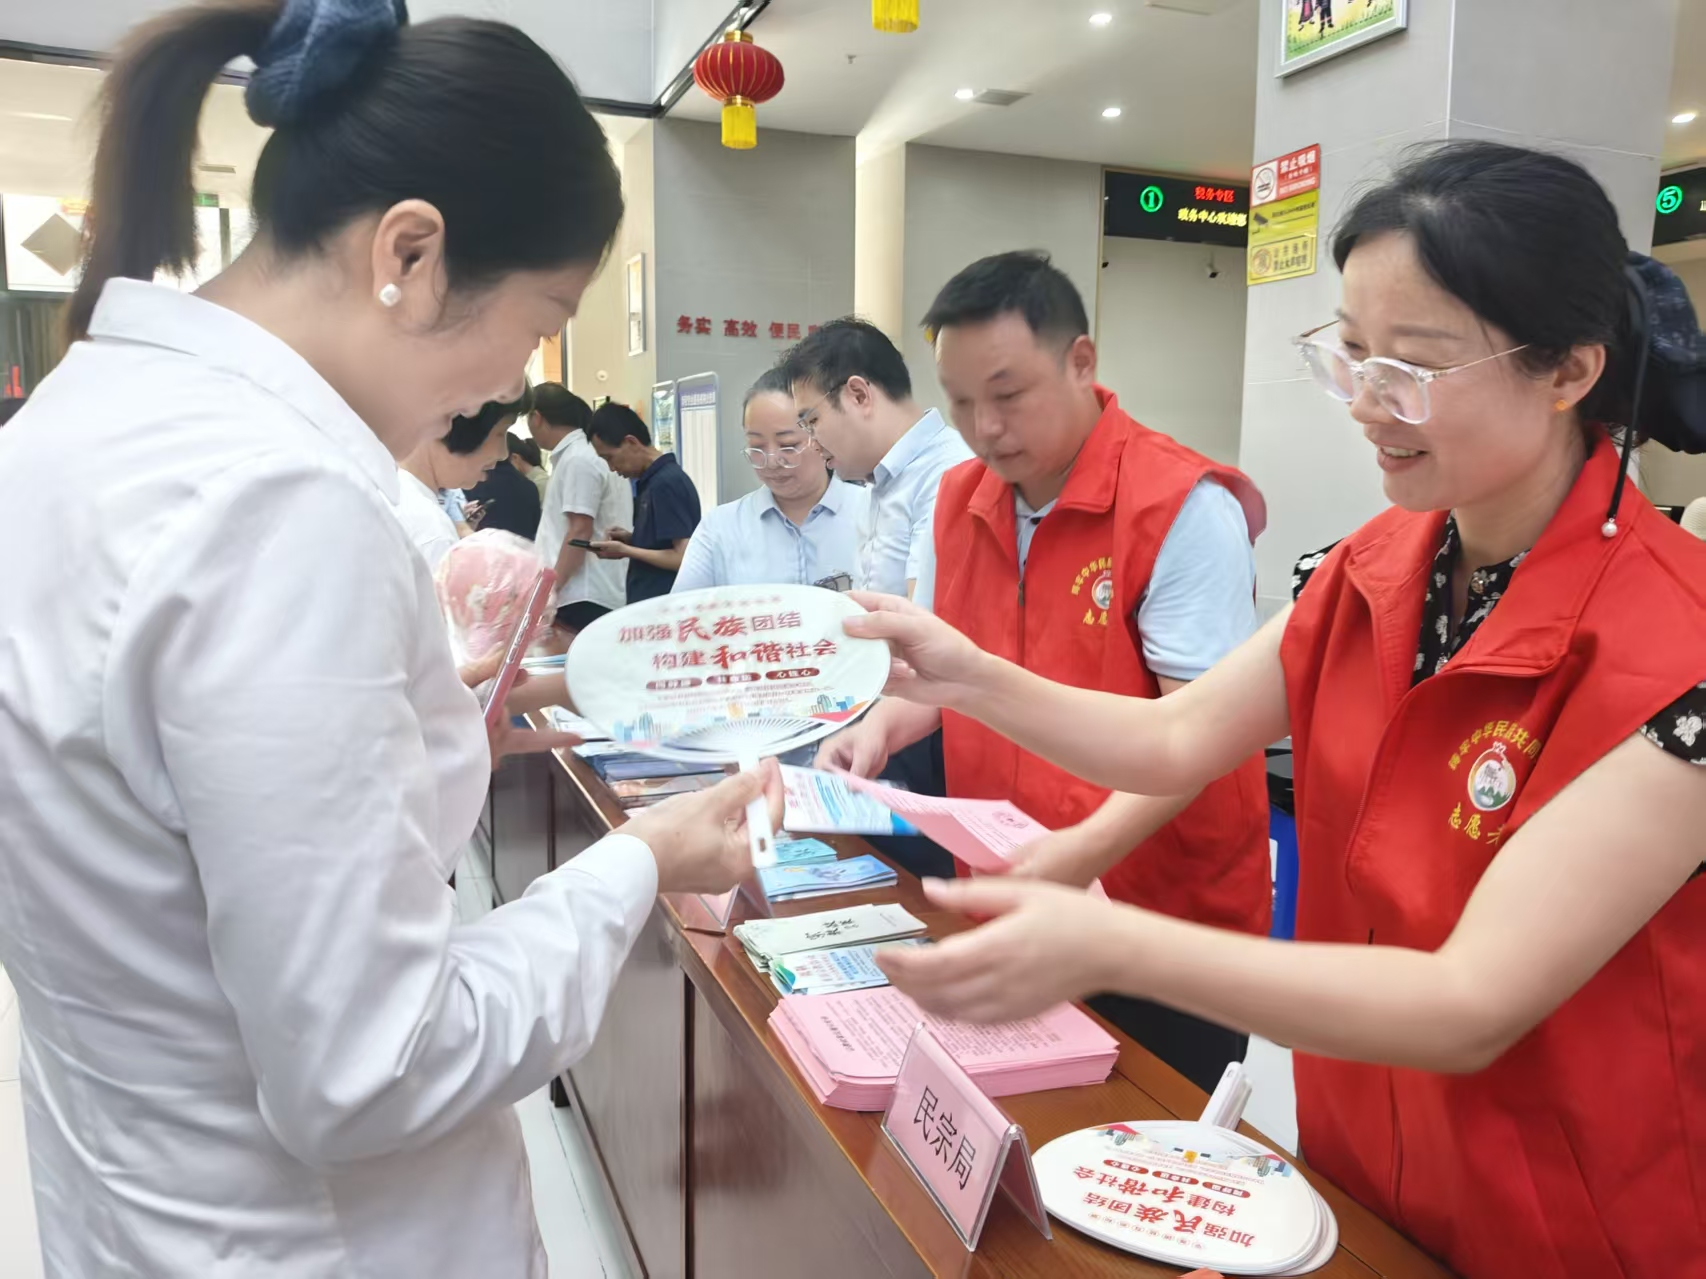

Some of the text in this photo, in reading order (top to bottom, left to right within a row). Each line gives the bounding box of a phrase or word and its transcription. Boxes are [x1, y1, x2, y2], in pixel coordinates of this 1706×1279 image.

[1194, 186, 1235, 203] 税务专区
[677, 315, 712, 335] 务实
[723, 318, 758, 338] 高效
[768, 321, 802, 340] 便民
[618, 611, 802, 644] 加强民族团结
[652, 638, 837, 669] 构建和谐社会
[913, 1085, 977, 1191] 民宗局
[1073, 1166, 1237, 1217] 构建和谐社会
[1083, 1192, 1255, 1248] 加强民族团结
